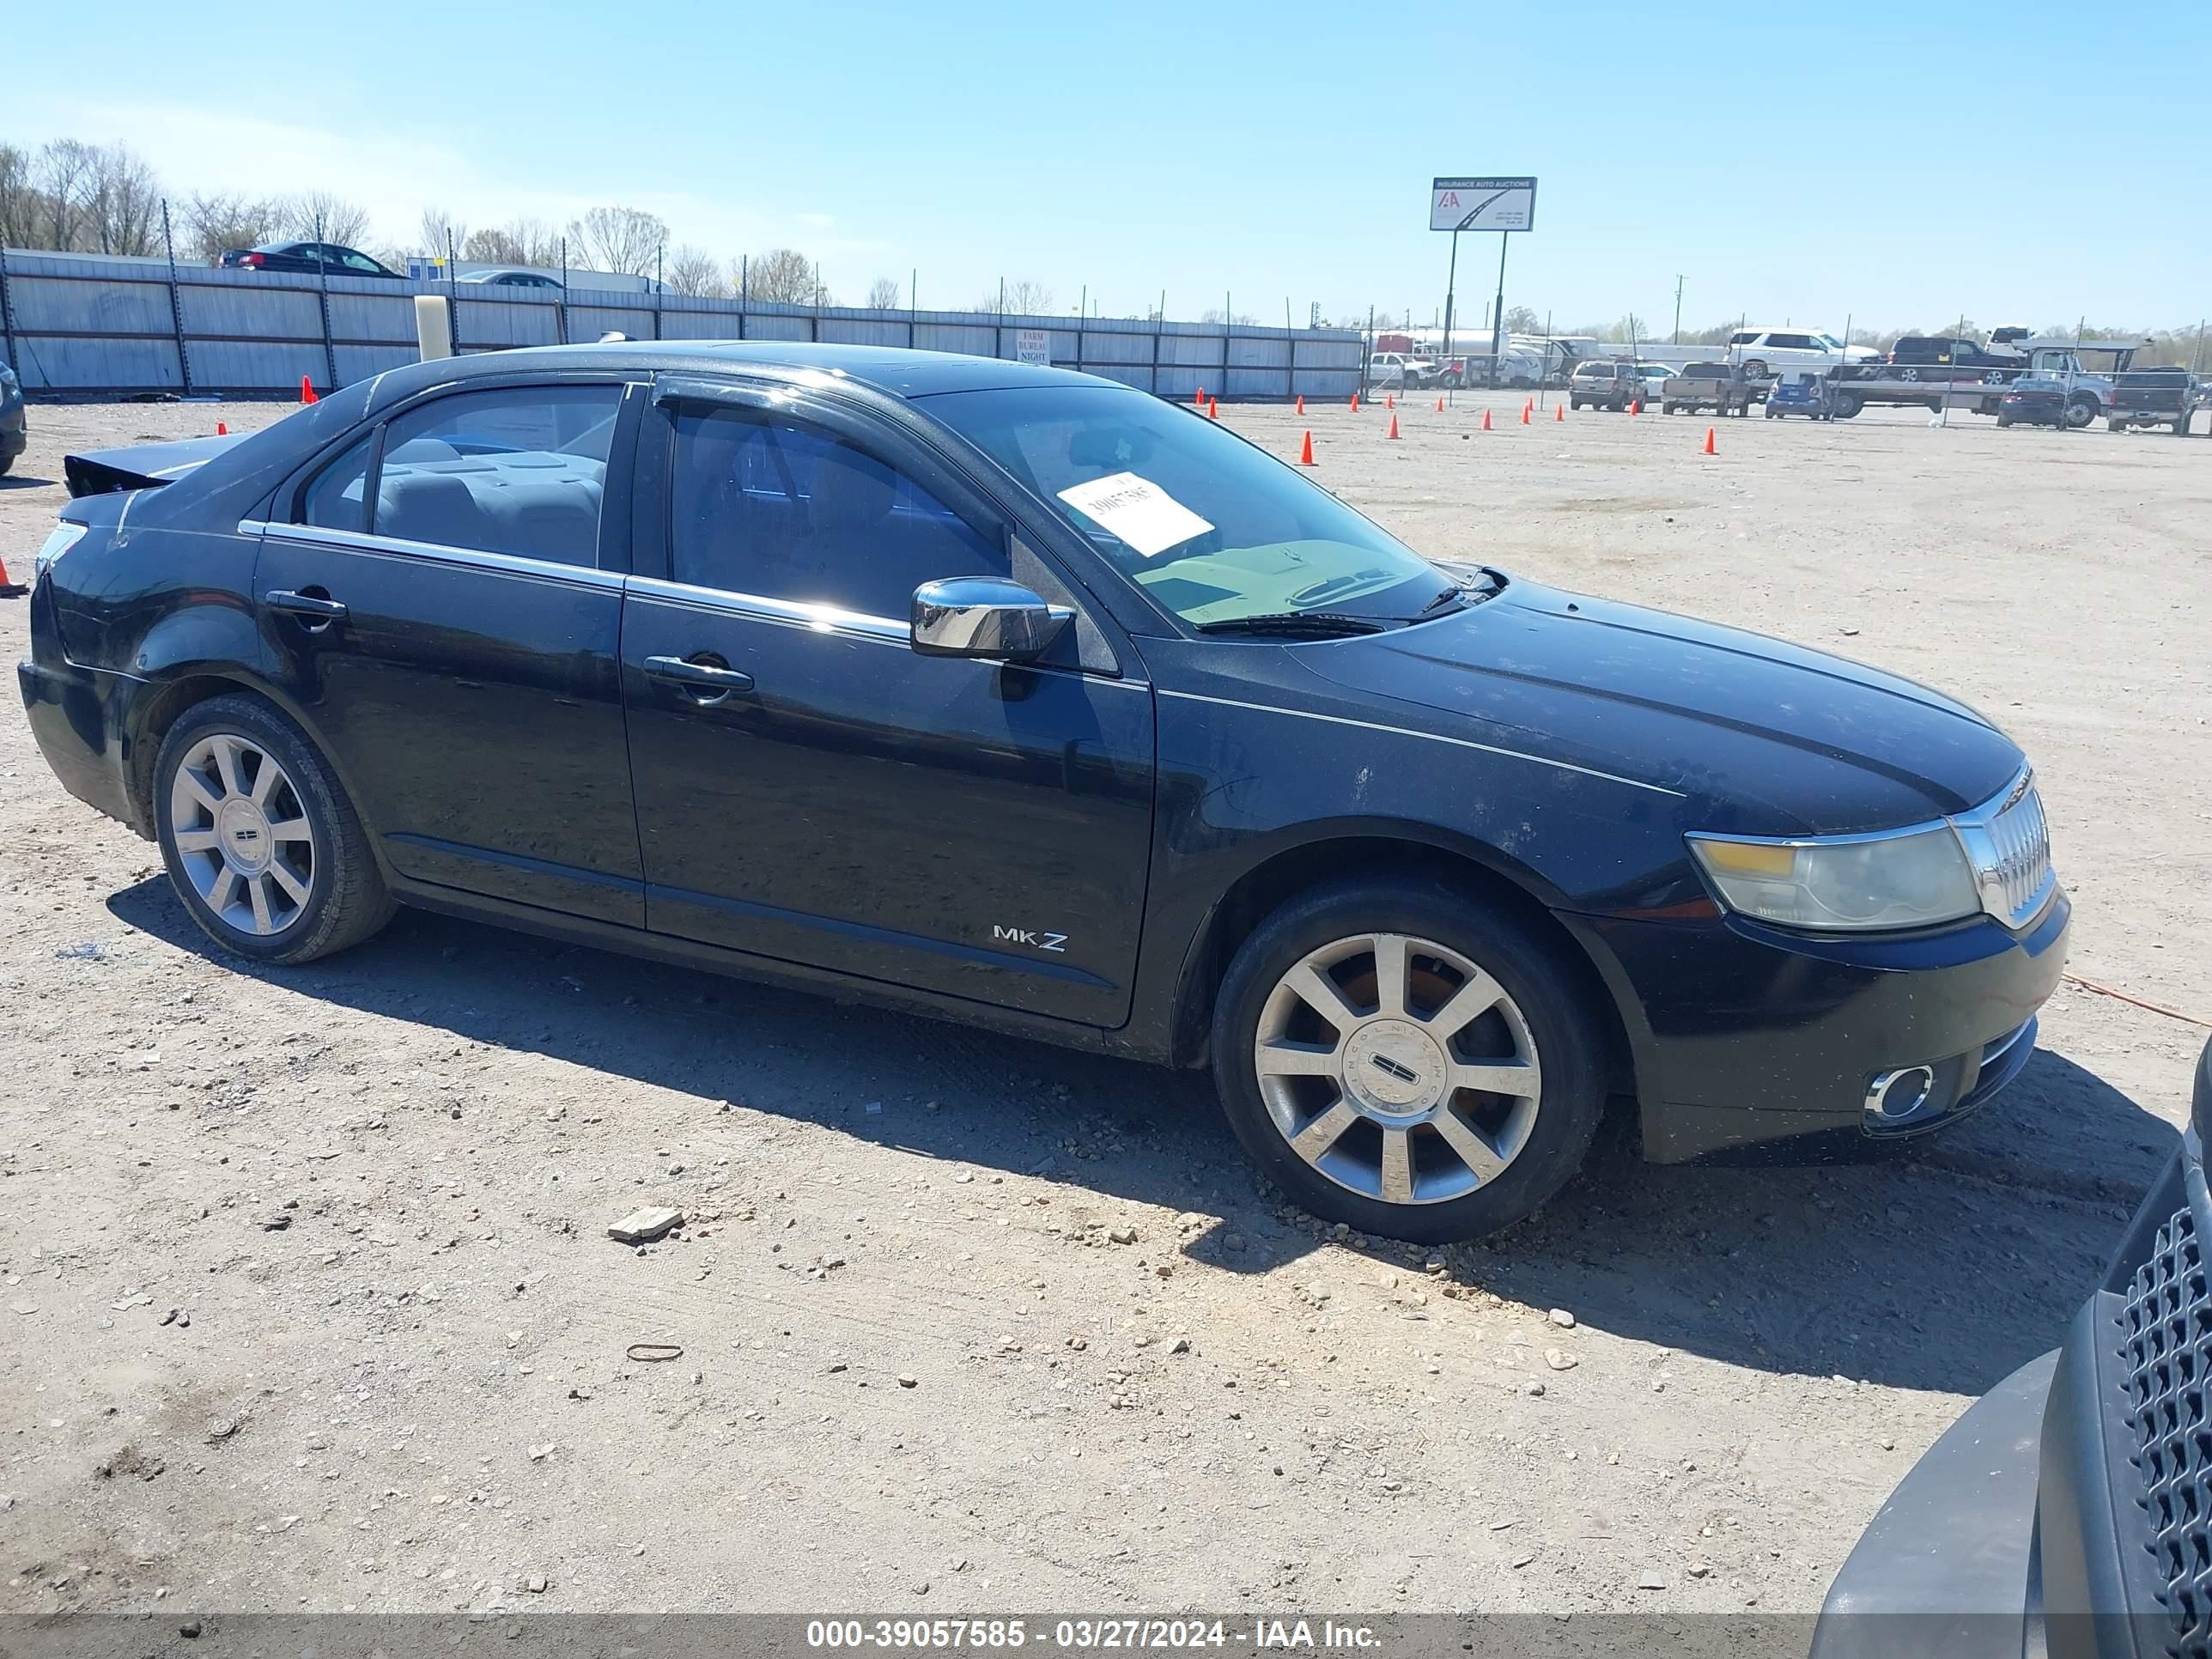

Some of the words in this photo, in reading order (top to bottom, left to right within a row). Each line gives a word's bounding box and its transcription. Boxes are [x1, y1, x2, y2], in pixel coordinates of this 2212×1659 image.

[1024, 331, 1044, 341] FARM
[1018, 340, 1048, 351] BUREAU
[994, 924, 1068, 952] MKZ
